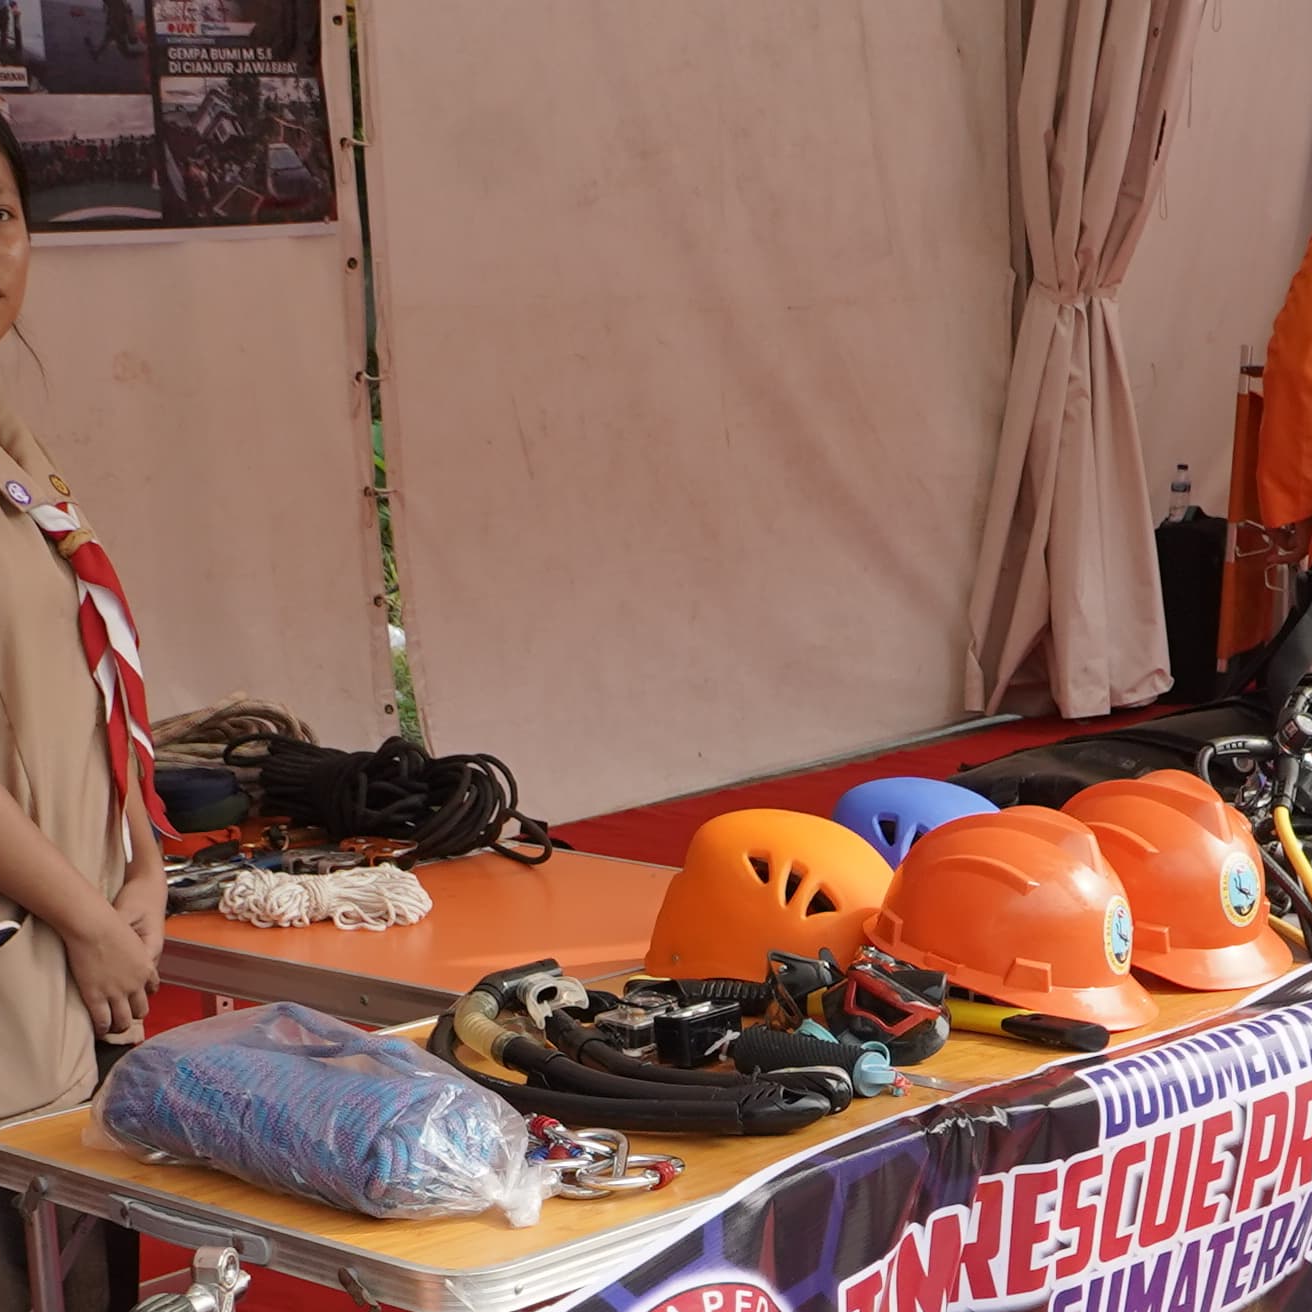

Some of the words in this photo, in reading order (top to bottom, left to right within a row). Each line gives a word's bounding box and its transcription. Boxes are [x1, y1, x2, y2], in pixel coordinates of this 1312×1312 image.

[167, 47, 209, 60] GEMPA
[183, 61, 234, 74] CIANJUR
[948, 1111, 1234, 1301] RESCUE
